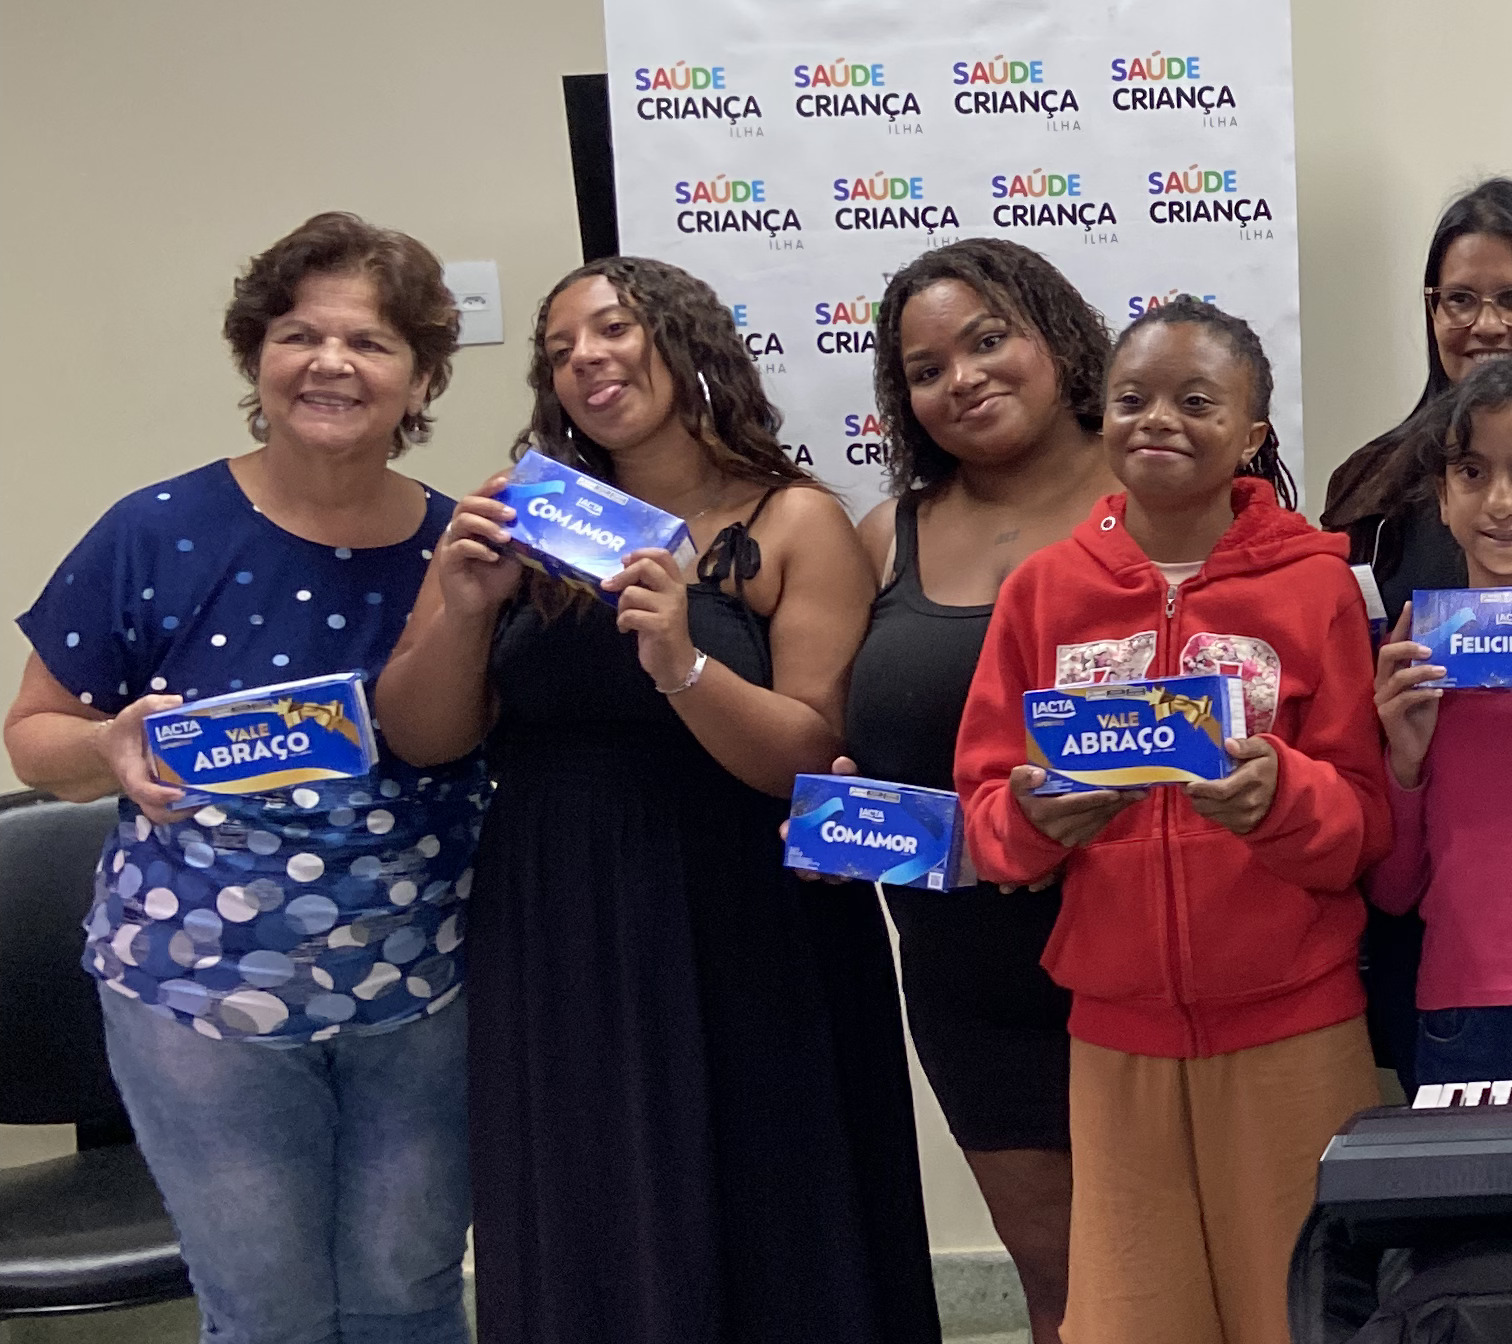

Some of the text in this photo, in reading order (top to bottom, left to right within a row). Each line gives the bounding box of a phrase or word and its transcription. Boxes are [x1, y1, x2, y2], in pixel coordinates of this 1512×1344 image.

[635, 60, 726, 91] SAÚDE
[794, 58, 885, 88] SAÚDE
[953, 55, 1043, 85] SAÚDE
[1111, 50, 1200, 82] SAÚDE
[637, 95, 762, 125] CRIANÇA
[796, 92, 921, 122] CRIANÇA
[954, 89, 1079, 119] CRIANÇA
[1112, 85, 1236, 115] CRIANÇA
[730, 127, 764, 138] ILHA
[888, 124, 923, 135] ILHA
[1047, 120, 1081, 132] ILHA
[1203, 116, 1237, 128] ILHA
[675, 174, 766, 204] SAÚDE
[833, 171, 924, 201] SAÚDE
[992, 168, 1081, 198] SAÚDE
[1148, 164, 1237, 195] SAÚDE
[677, 208, 802, 238] CRIANÇA
[835, 205, 960, 235] CRIANÇA
[993, 202, 1117, 232] CRIANÇA
[1149, 198, 1272, 228] CRIANÇA
[769, 240, 804, 250] ILHA
[1084, 233, 1119, 244] ILHA
[1240, 229, 1273, 240] ILHA
[817, 330, 877, 354] CRIA
[528, 497, 626, 552] COM AMOR
[1032, 699, 1077, 719] LACTA
[1097, 712, 1139, 729] VALE
[155, 720, 203, 742] LACTA
[225, 722, 271, 743] VALE
[1061, 726, 1176, 756] ABRAÇO
[193, 731, 310, 772] ABRAÇO
[821, 820, 918, 854] COM AMOR
